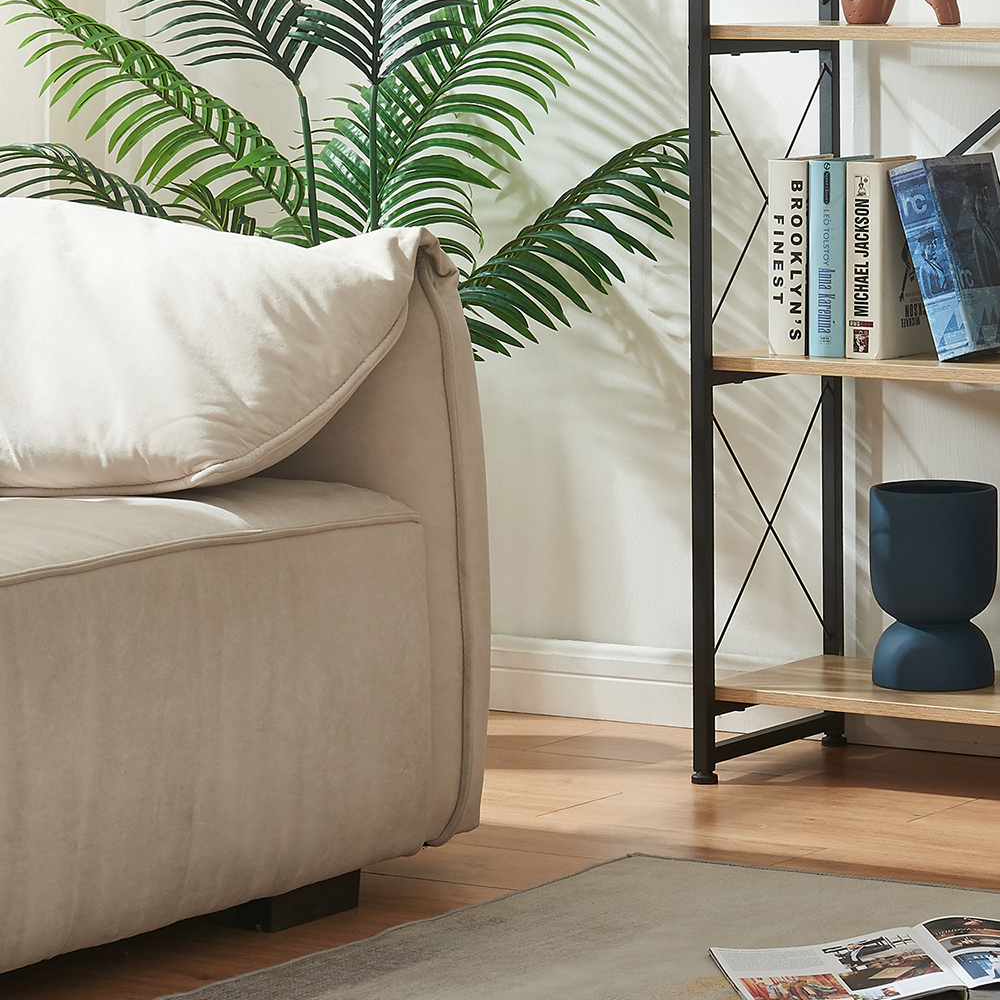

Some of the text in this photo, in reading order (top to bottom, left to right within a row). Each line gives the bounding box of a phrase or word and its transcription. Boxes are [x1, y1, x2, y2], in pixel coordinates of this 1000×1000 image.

[772, 215, 784, 305] FINEST
[789, 180, 803, 342] BROOKLYN'S
[818, 268, 836, 290] Anna
[822, 228, 830, 266] TOLSTOY
[854, 198, 870, 317] MICHAEL JACKSON
[818, 293, 835, 334] Karenina
